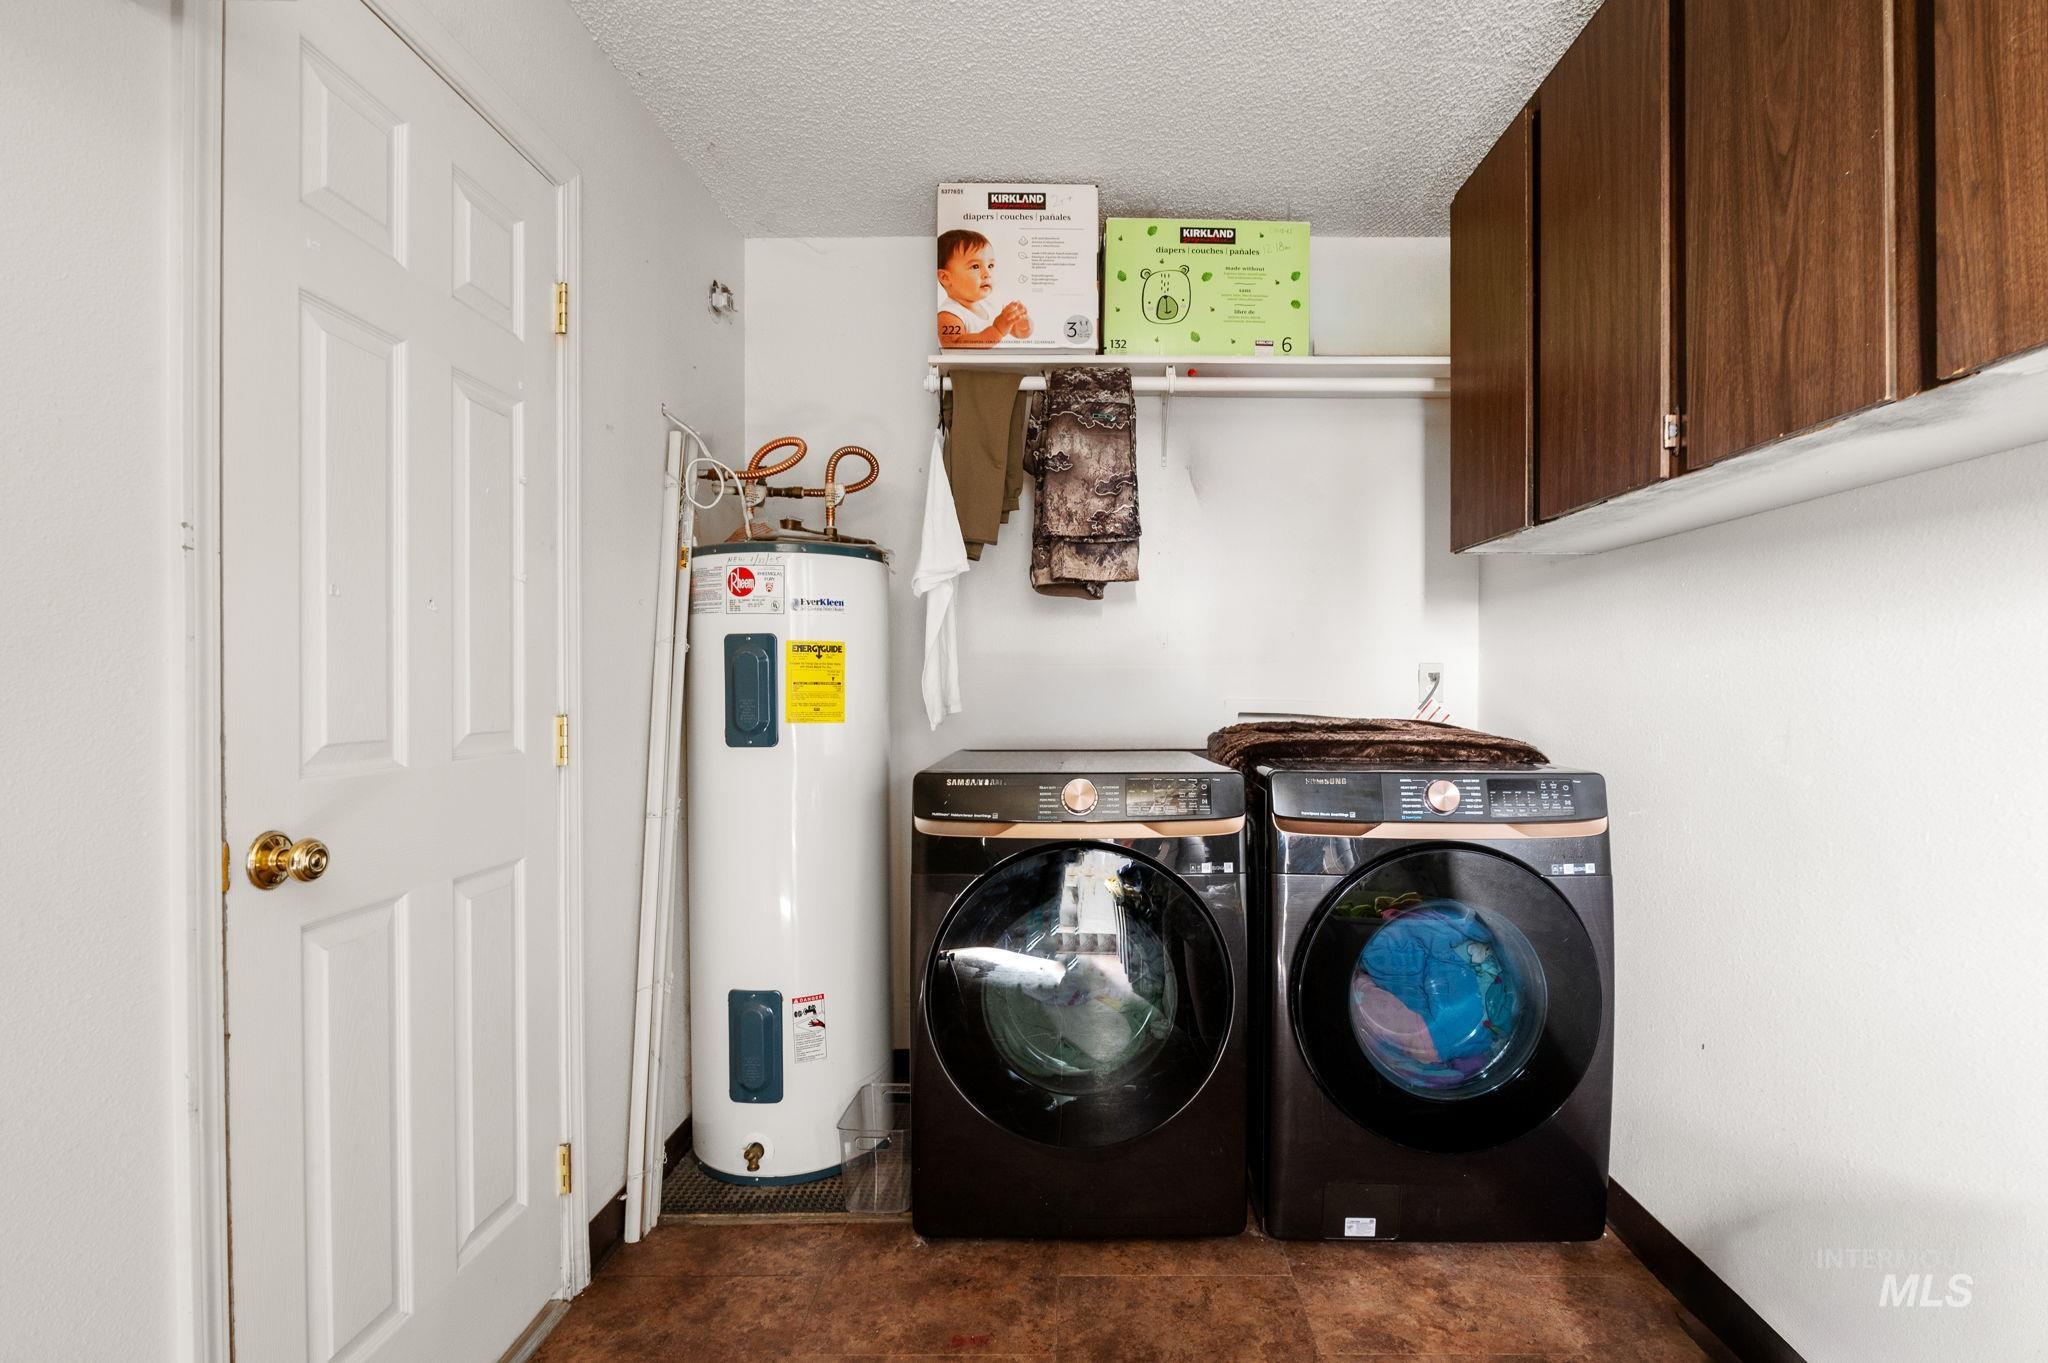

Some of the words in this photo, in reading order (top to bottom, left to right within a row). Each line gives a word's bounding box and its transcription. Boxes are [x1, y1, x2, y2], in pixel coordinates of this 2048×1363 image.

[991, 194, 1044, 204] KIRKLAND
[963, 213, 994, 222] diapers
[1000, 213, 1034, 221] couches
[1183, 229, 1234, 238] KIRKLAND
[1155, 246, 1186, 255] diapers
[1191, 247, 1224, 255] couches
[942, 326, 961, 335] 222
[1067, 322, 1077, 338] 3
[1110, 339, 1127, 349] 132
[1282, 337, 1292, 352] 6
[730, 568, 755, 593] Rheem
[800, 598, 844, 607] EverKleen
[792, 645, 843, 653] ENERGYGUIDE
[799, 995, 823, 1003] DANGER
